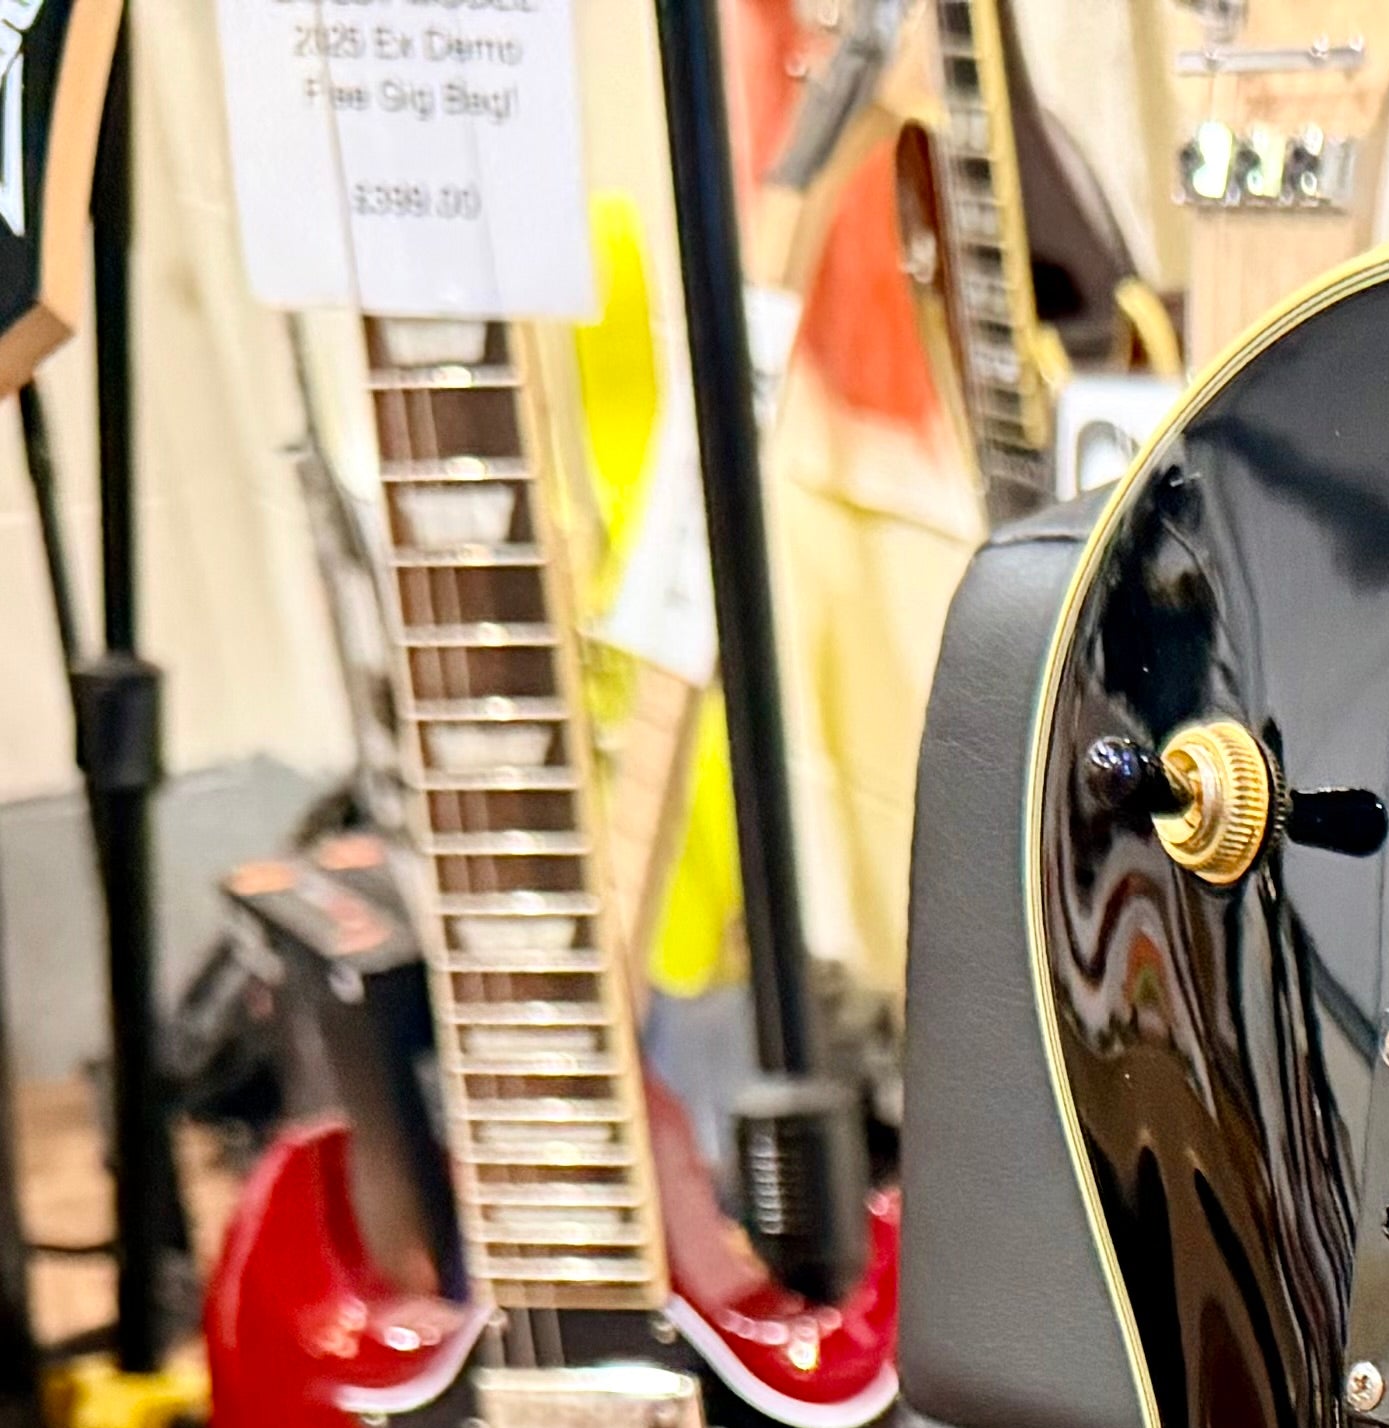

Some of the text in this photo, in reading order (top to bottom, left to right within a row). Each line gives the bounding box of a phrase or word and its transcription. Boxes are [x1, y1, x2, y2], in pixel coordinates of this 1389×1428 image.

[374, 26, 413, 60] Ex
[424, 29, 523, 65] Demo
[380, 79, 435, 122] Gig
